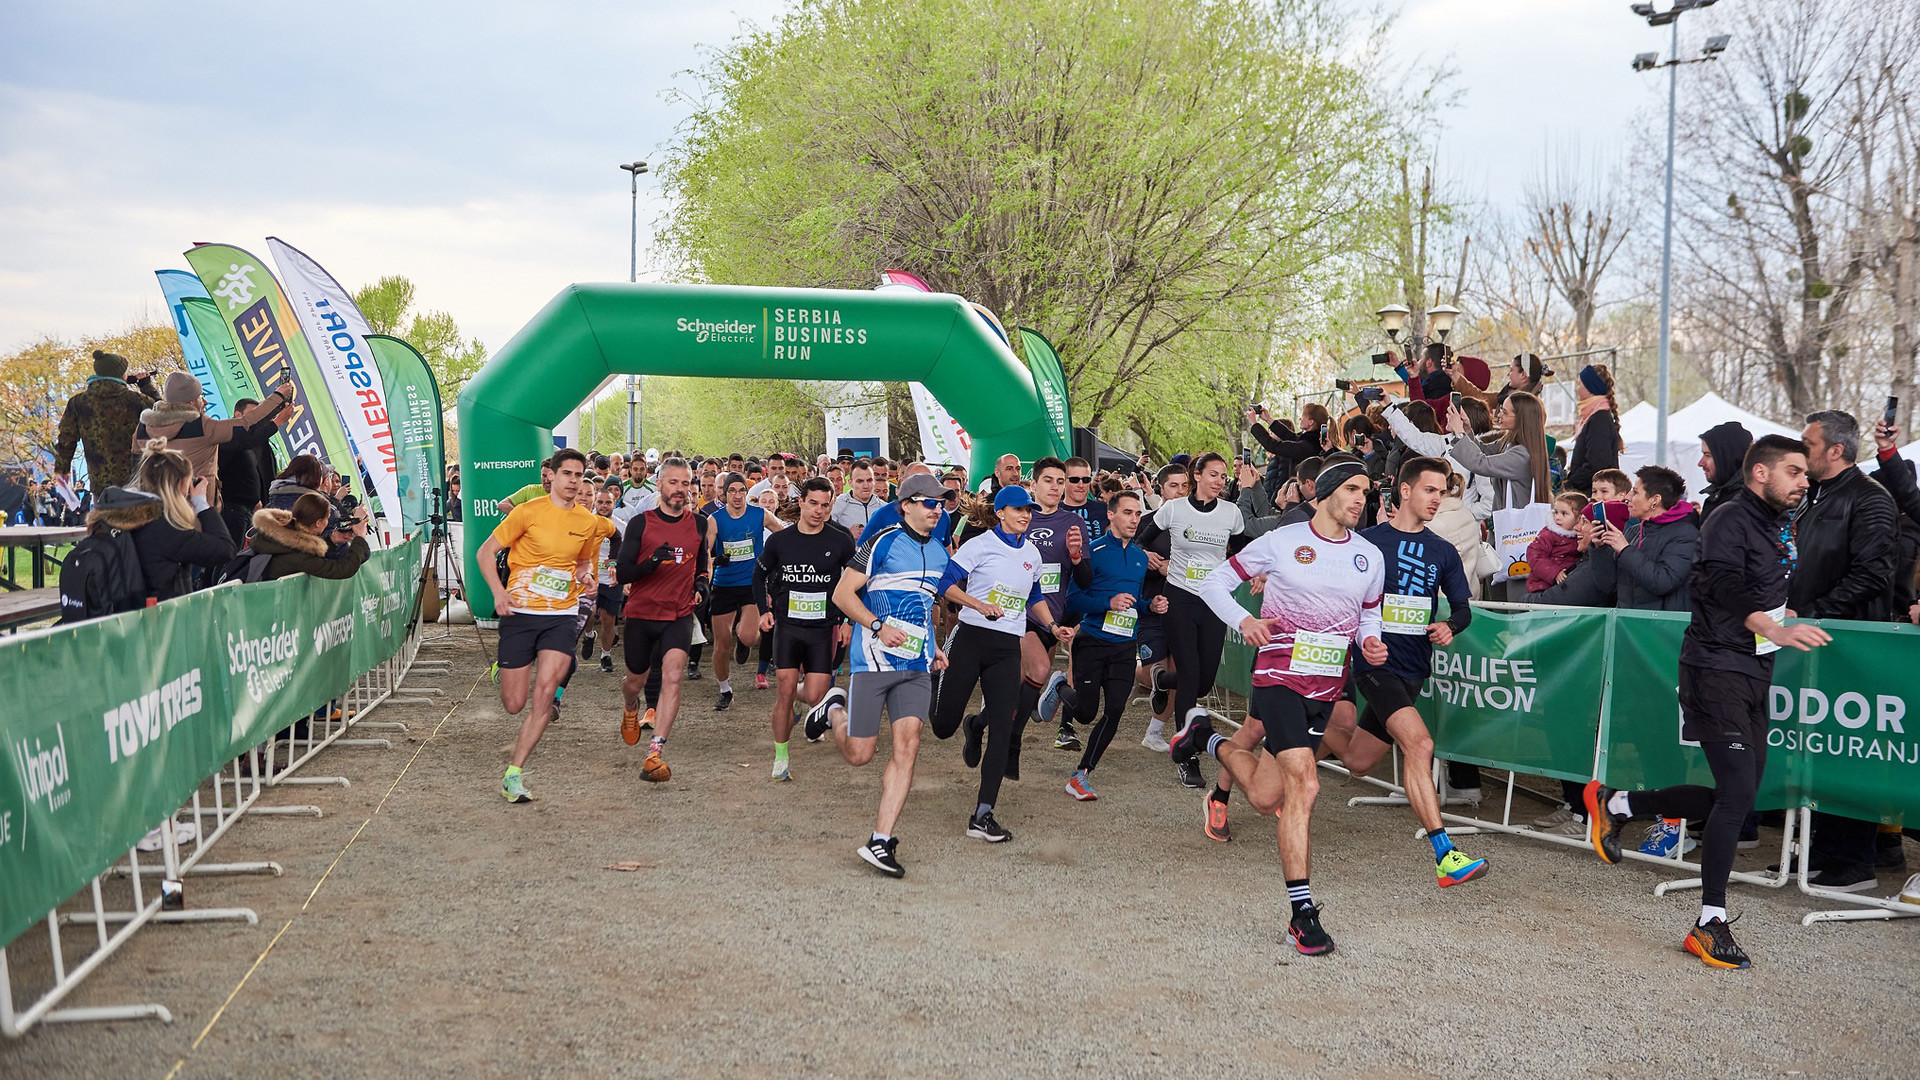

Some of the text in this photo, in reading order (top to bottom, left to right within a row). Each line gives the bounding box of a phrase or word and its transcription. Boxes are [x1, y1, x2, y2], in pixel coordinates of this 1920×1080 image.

[775, 308, 842, 325] SERBIA
[676, 317, 756, 338] Schneider
[775, 325, 868, 345] BUSINESS
[711, 333, 756, 343] Electric
[775, 344, 811, 361] RUN
[481, 459, 536, 470] INTERSPORT
[474, 499, 500, 516] BRC
[536, 574, 567, 590] 0609
[782, 573, 831, 583] HOLDING
[1041, 574, 1057, 584] 07
[794, 600, 821, 611] 1013
[993, 593, 1022, 608] 1508
[1111, 614, 1133, 628] 1014
[1391, 609, 1426, 624] 1193
[227, 621, 300, 677] Schneider
[902, 636, 920, 650] 44
[1297, 645, 1342, 663] 3050
[1768, 685, 1906, 734] DDOR
[17, 722, 69, 813] Unipol
